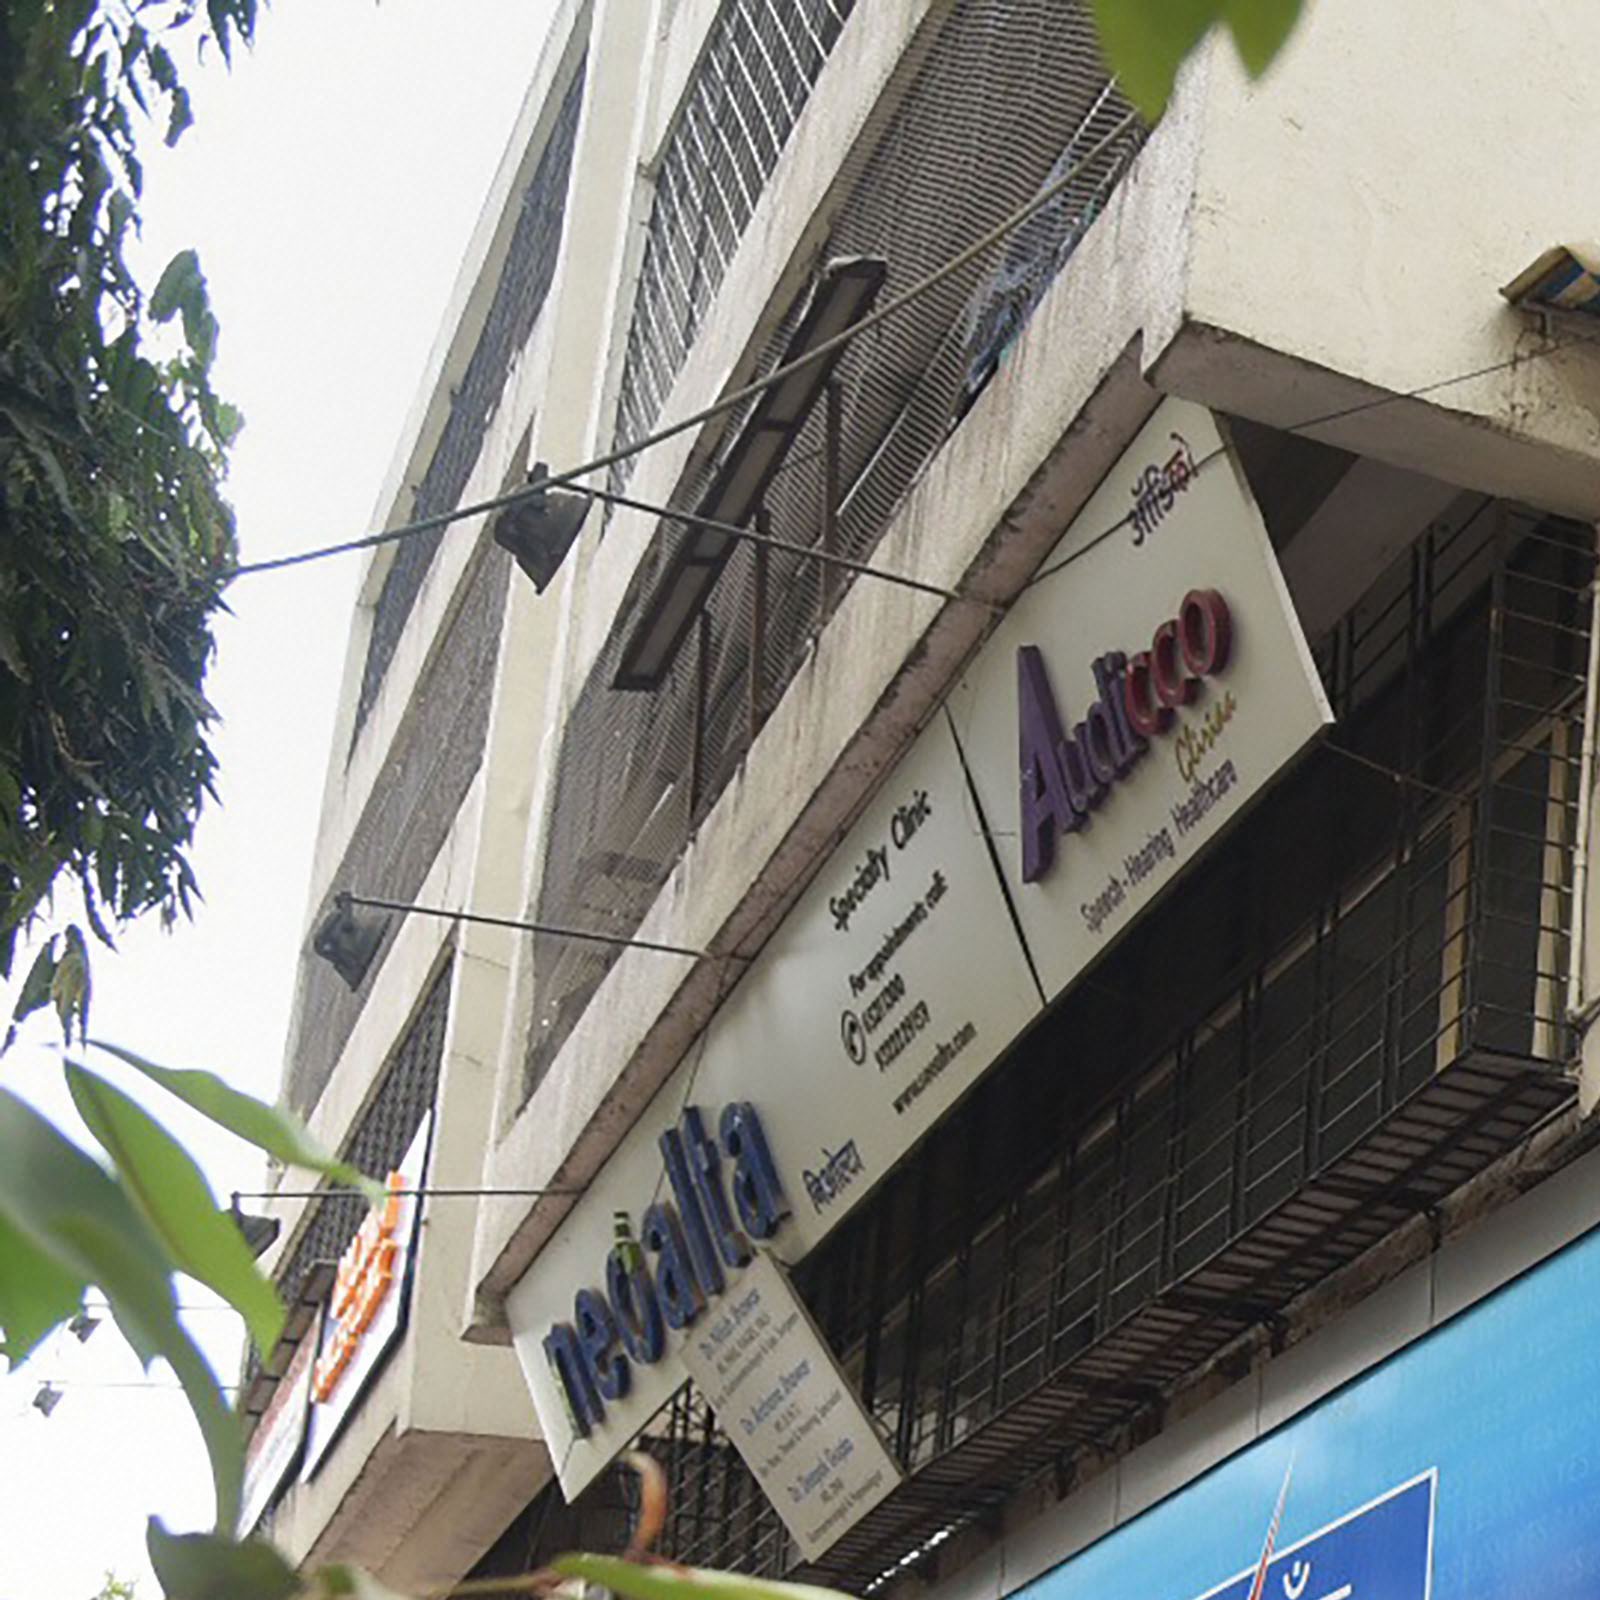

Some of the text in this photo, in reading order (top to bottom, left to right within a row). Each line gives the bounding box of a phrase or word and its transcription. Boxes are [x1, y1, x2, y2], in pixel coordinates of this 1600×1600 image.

[891, 790, 932, 850] Clinic
[1017, 588, 1236, 884] Audicco
[543, 1100, 792, 1440] neoalta
